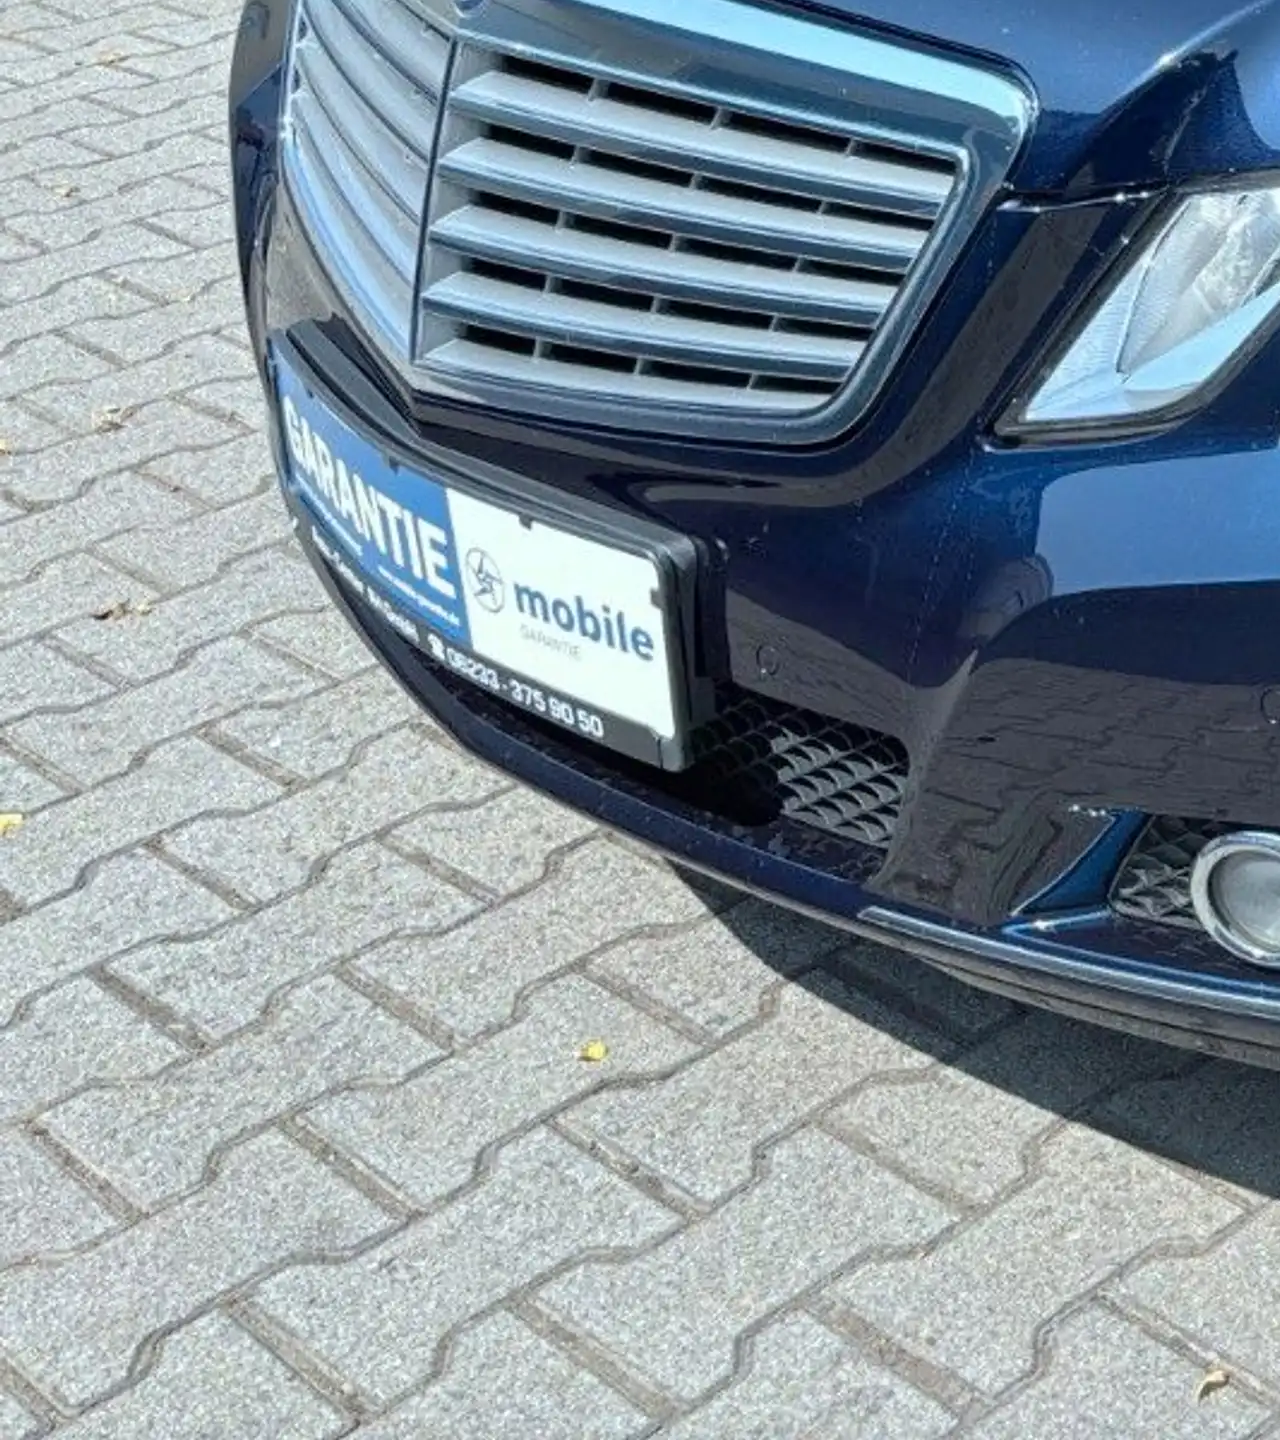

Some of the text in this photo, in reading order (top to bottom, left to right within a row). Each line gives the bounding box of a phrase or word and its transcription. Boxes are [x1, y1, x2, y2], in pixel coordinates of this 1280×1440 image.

[283, 394, 457, 600] GARANTIE
[513, 582, 654, 661] mobile
[575, 707, 604, 738] 50
